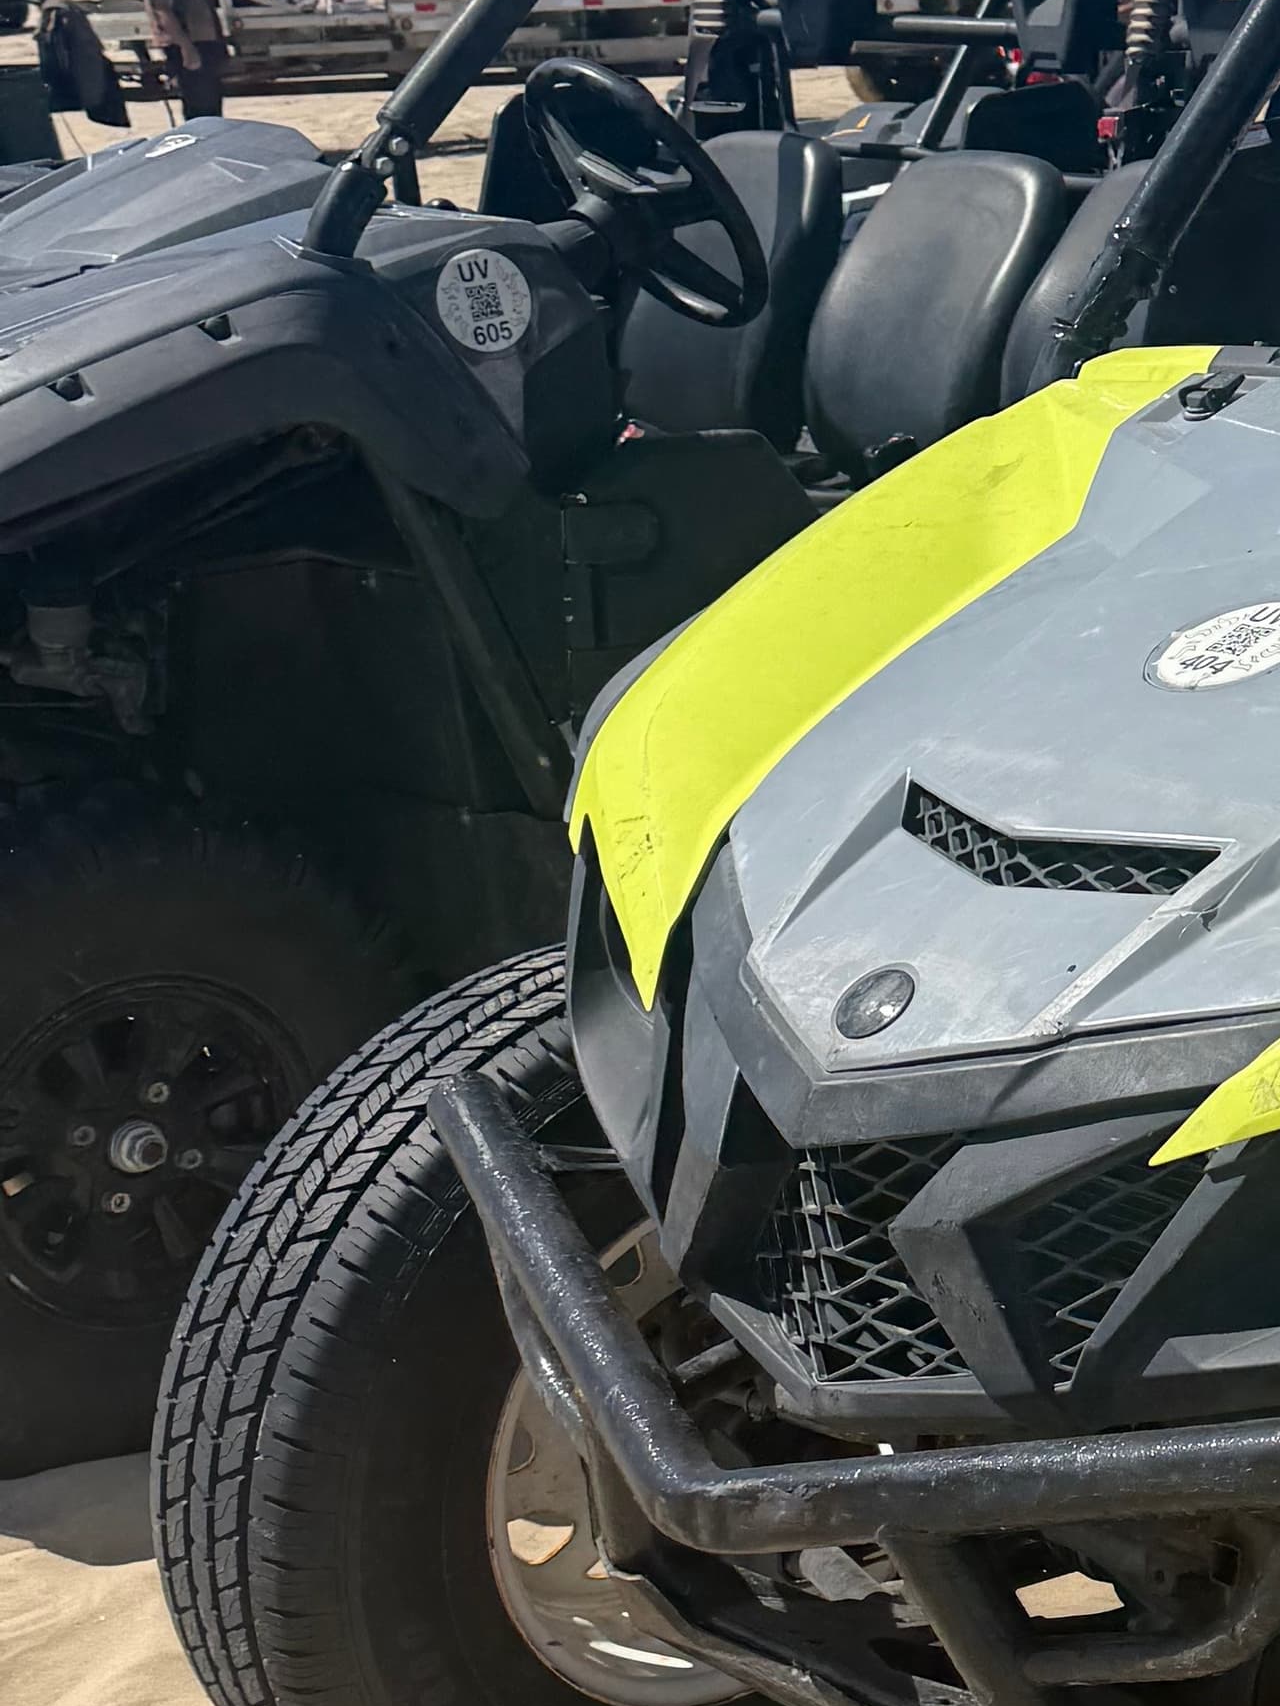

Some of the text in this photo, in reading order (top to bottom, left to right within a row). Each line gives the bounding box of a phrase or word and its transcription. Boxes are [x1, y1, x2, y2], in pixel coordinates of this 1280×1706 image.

[456, 258, 490, 283] UV
[473, 319, 514, 347] 605
[1178, 654, 1235, 675] 404
